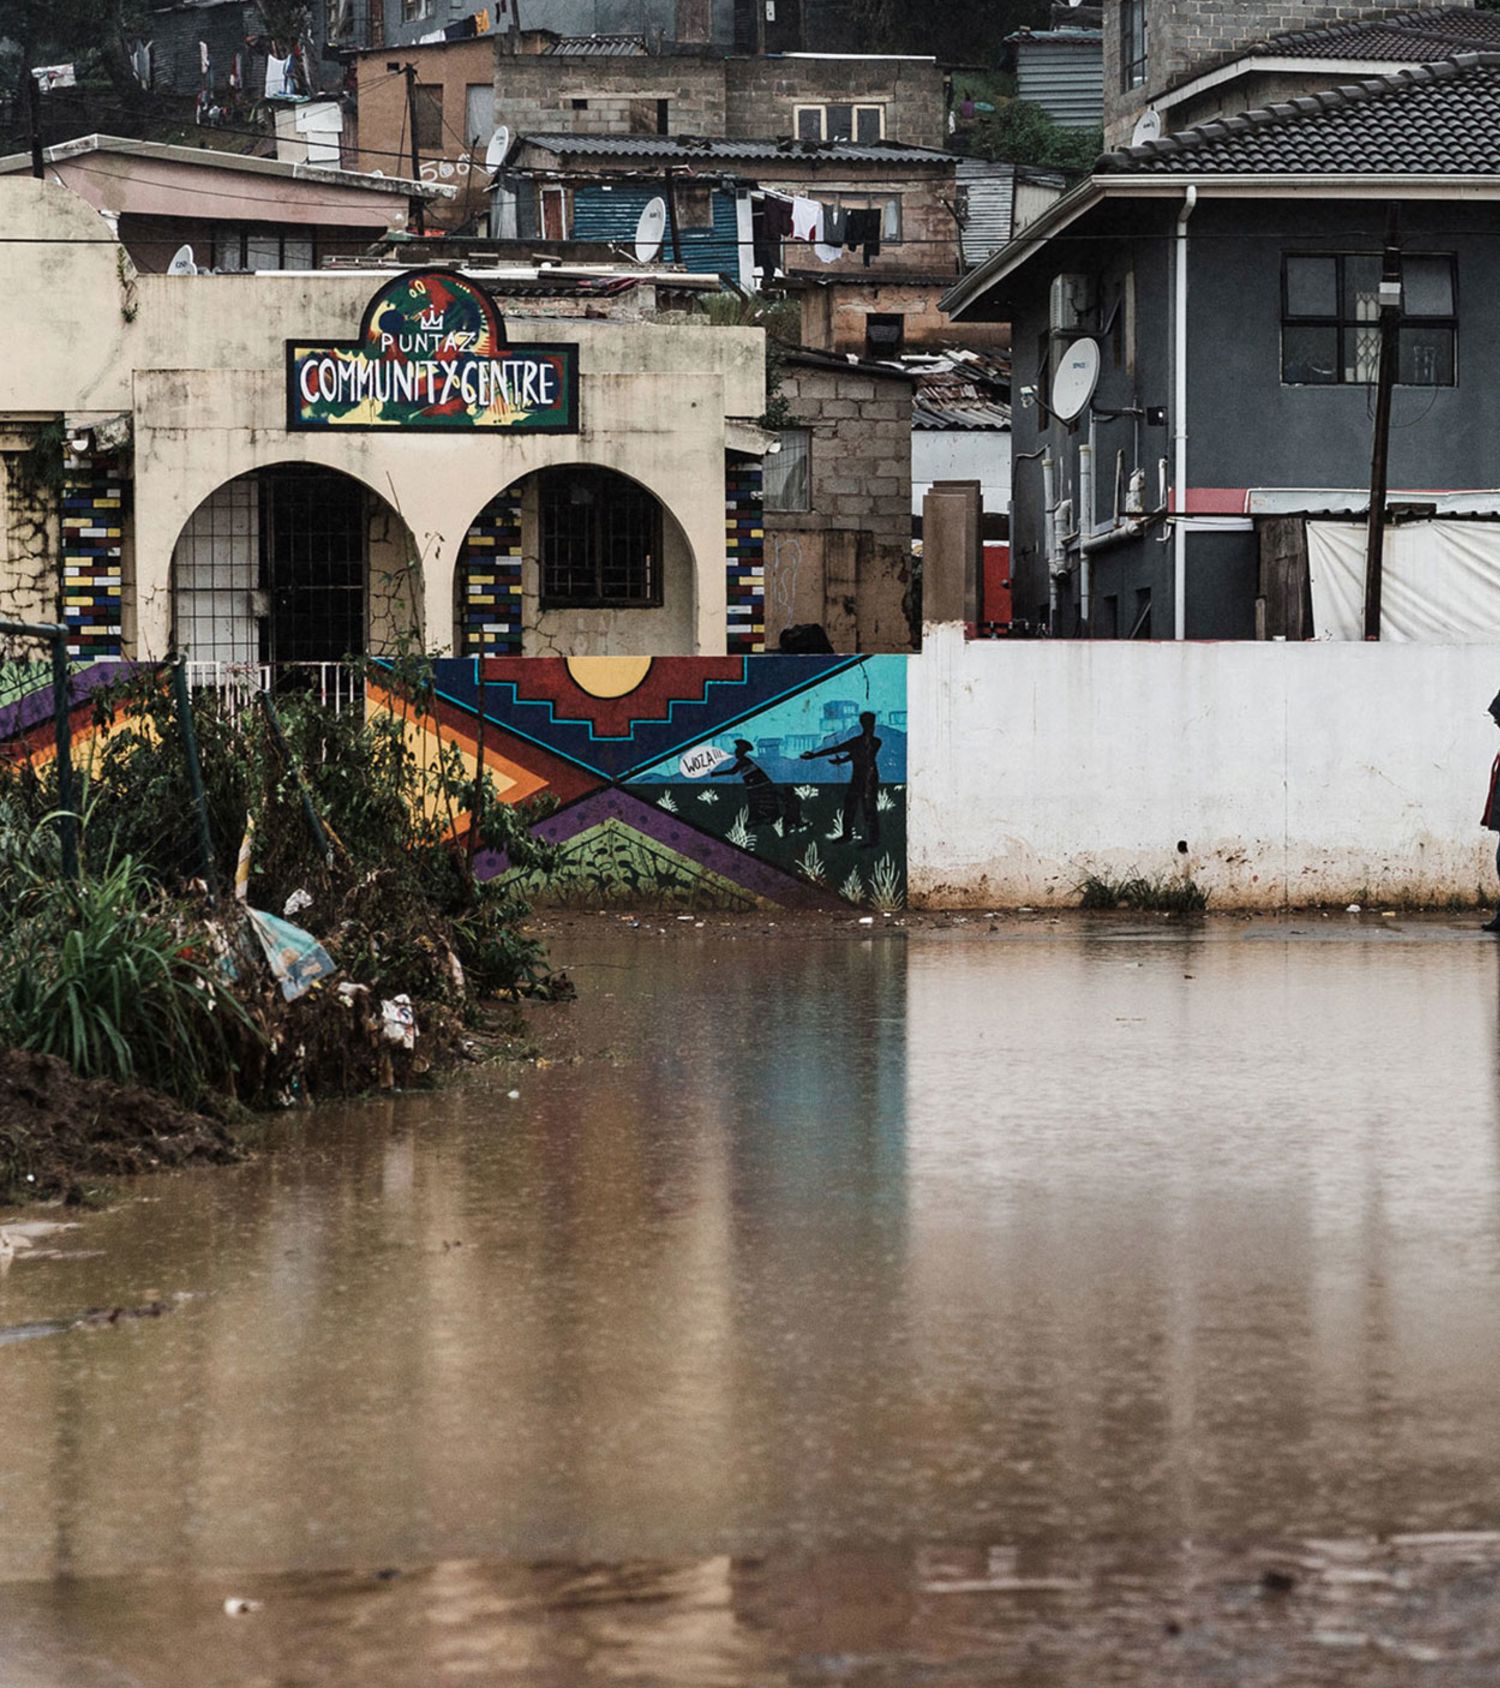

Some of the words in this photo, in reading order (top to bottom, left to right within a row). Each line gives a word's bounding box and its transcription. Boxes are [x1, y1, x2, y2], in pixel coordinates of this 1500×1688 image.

[381, 332, 475, 352] PUNTAZ
[300, 359, 455, 404] COMMUNITY
[460, 360, 554, 405] CENTRE
